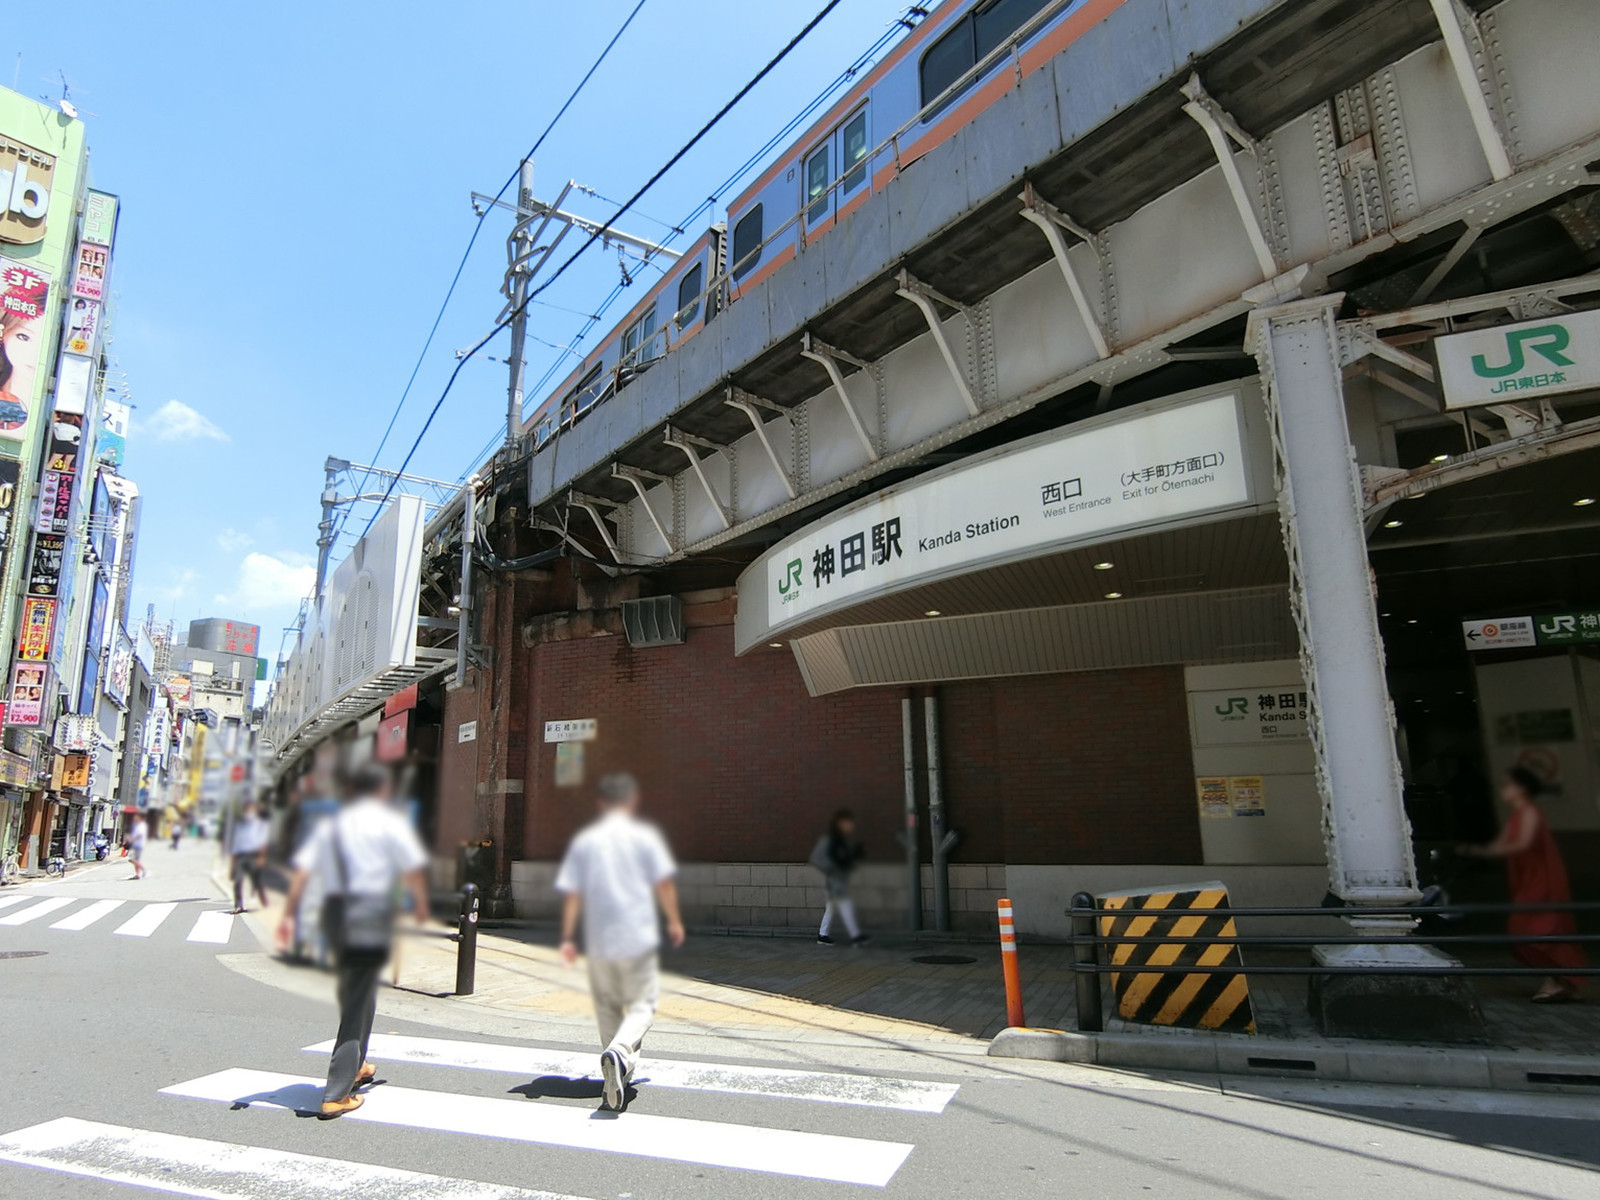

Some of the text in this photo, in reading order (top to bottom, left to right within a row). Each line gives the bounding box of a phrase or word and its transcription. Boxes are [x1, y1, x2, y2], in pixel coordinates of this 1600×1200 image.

[8, 270, 41, 290] 3F
[76, 285, 101, 296] ¥2,900
[4, 295, 37, 317] 神田本店
[1471, 324, 1576, 378] JR
[1490, 372, 1567, 394] JR東日本
[1041, 452, 1225, 506] 西口 （大手町方面口）
[1122, 488, 1142, 501] Exit
[1144, 483, 1159, 496] for
[1042, 497, 1112, 519] West Entrance
[918, 514, 1020, 552] Kanda Station
[812, 516, 903, 589] 神田駅
[778, 558, 803, 589] JR
[30, 609, 46, 648] 無料案内所
[1540, 616, 1577, 634] JR
[1580, 613, 1600, 628] 神
[1215, 697, 1249, 715] JR
[1259, 712, 1296, 722] Kanda
[10, 713, 38, 722] ¥2,900
